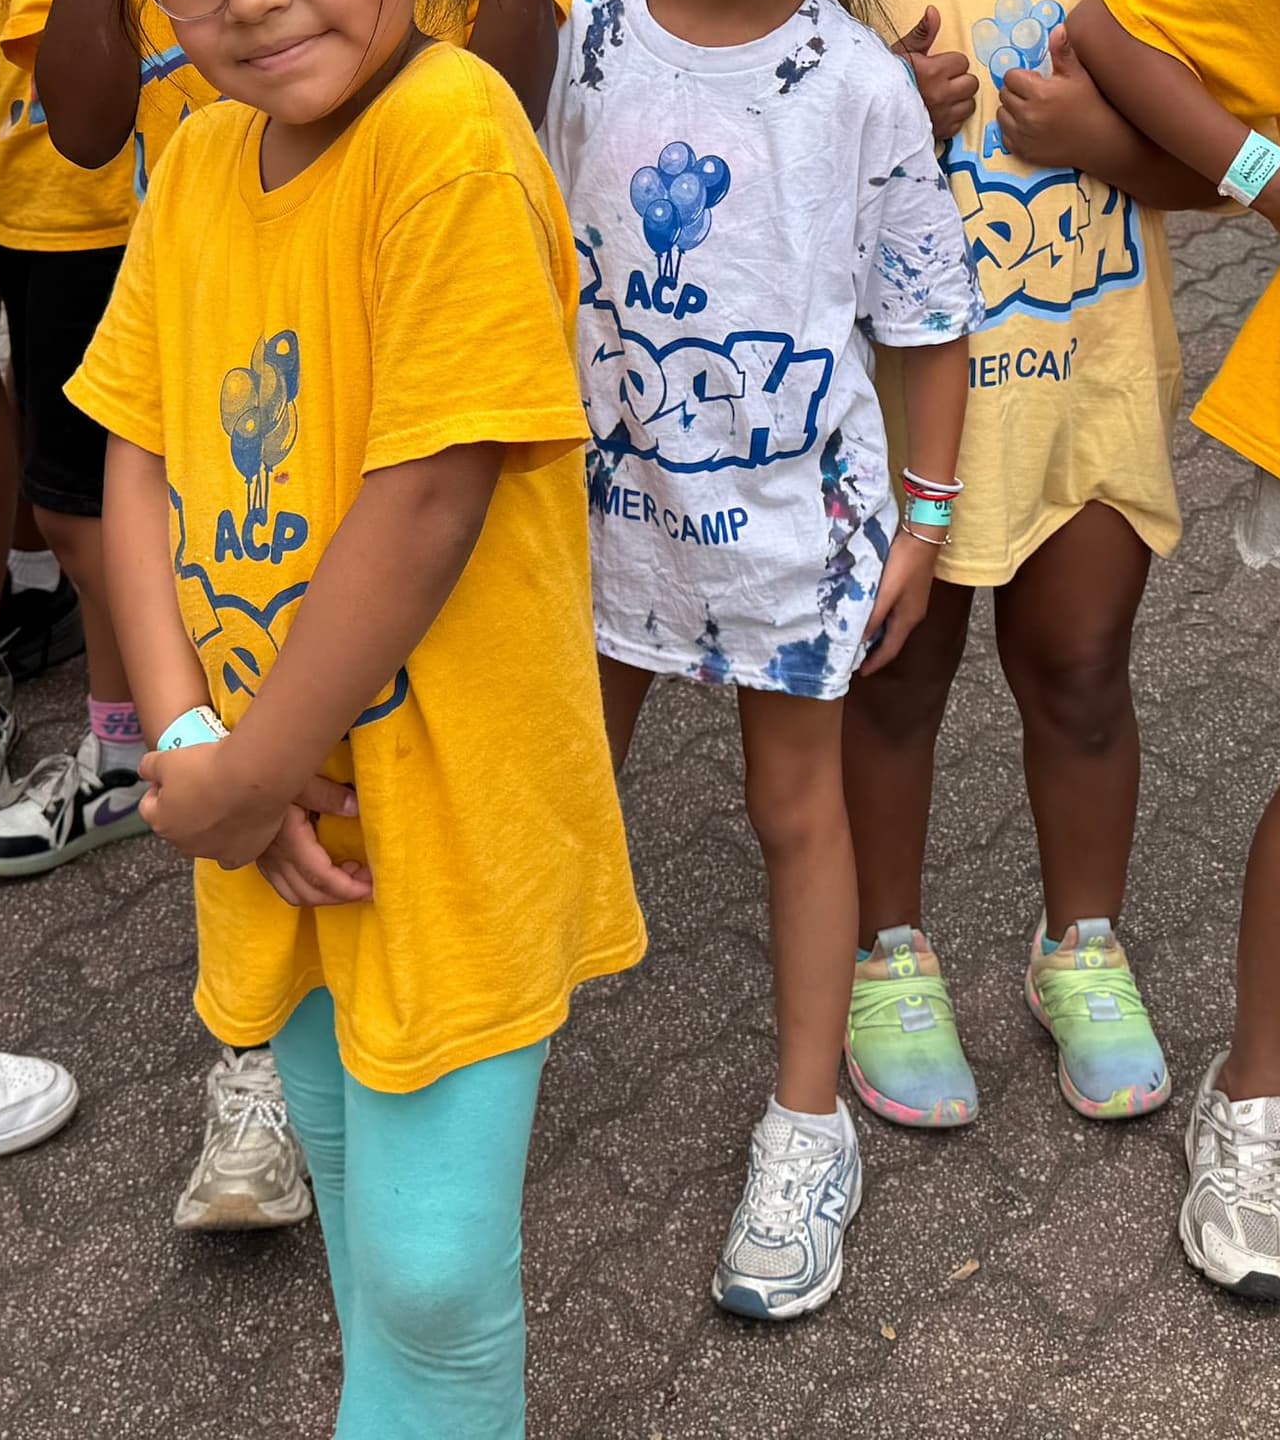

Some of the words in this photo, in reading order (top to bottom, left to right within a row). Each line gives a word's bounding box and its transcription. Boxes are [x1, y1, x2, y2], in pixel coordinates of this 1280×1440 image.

[625, 270, 708, 320] ACP
[214, 508, 308, 564] ACP
[663, 507, 749, 545] CAMP
